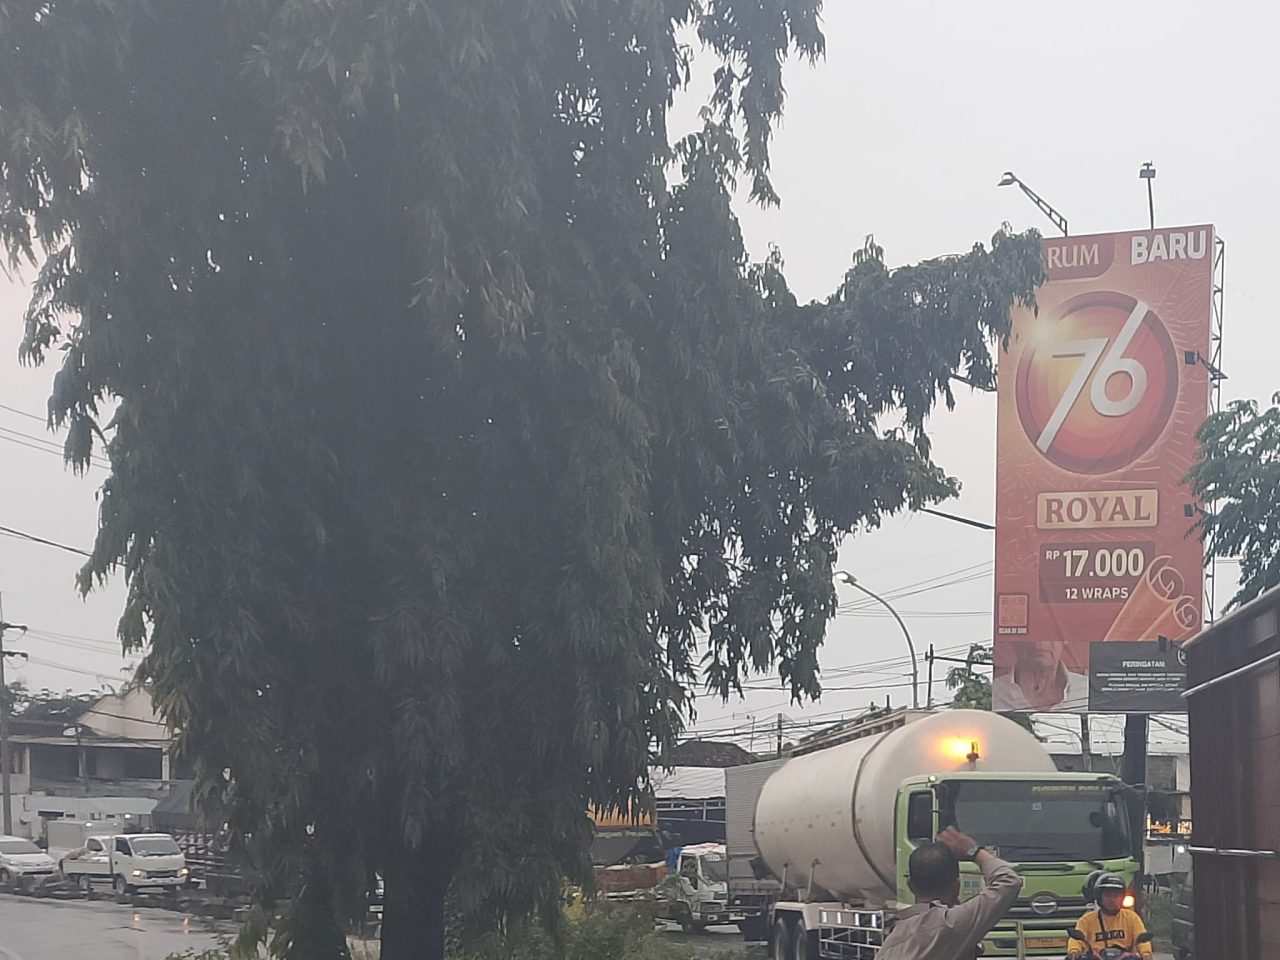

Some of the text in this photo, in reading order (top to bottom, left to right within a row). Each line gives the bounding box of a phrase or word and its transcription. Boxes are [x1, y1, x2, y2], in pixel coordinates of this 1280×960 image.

[1131, 230, 1207, 265] BARU
[1036, 300, 1149, 453] 76
[1044, 494, 1151, 523] ROYAL
[1046, 548, 1144, 577] RP 17.000
[1065, 587, 1129, 600] 12 WRAPS
